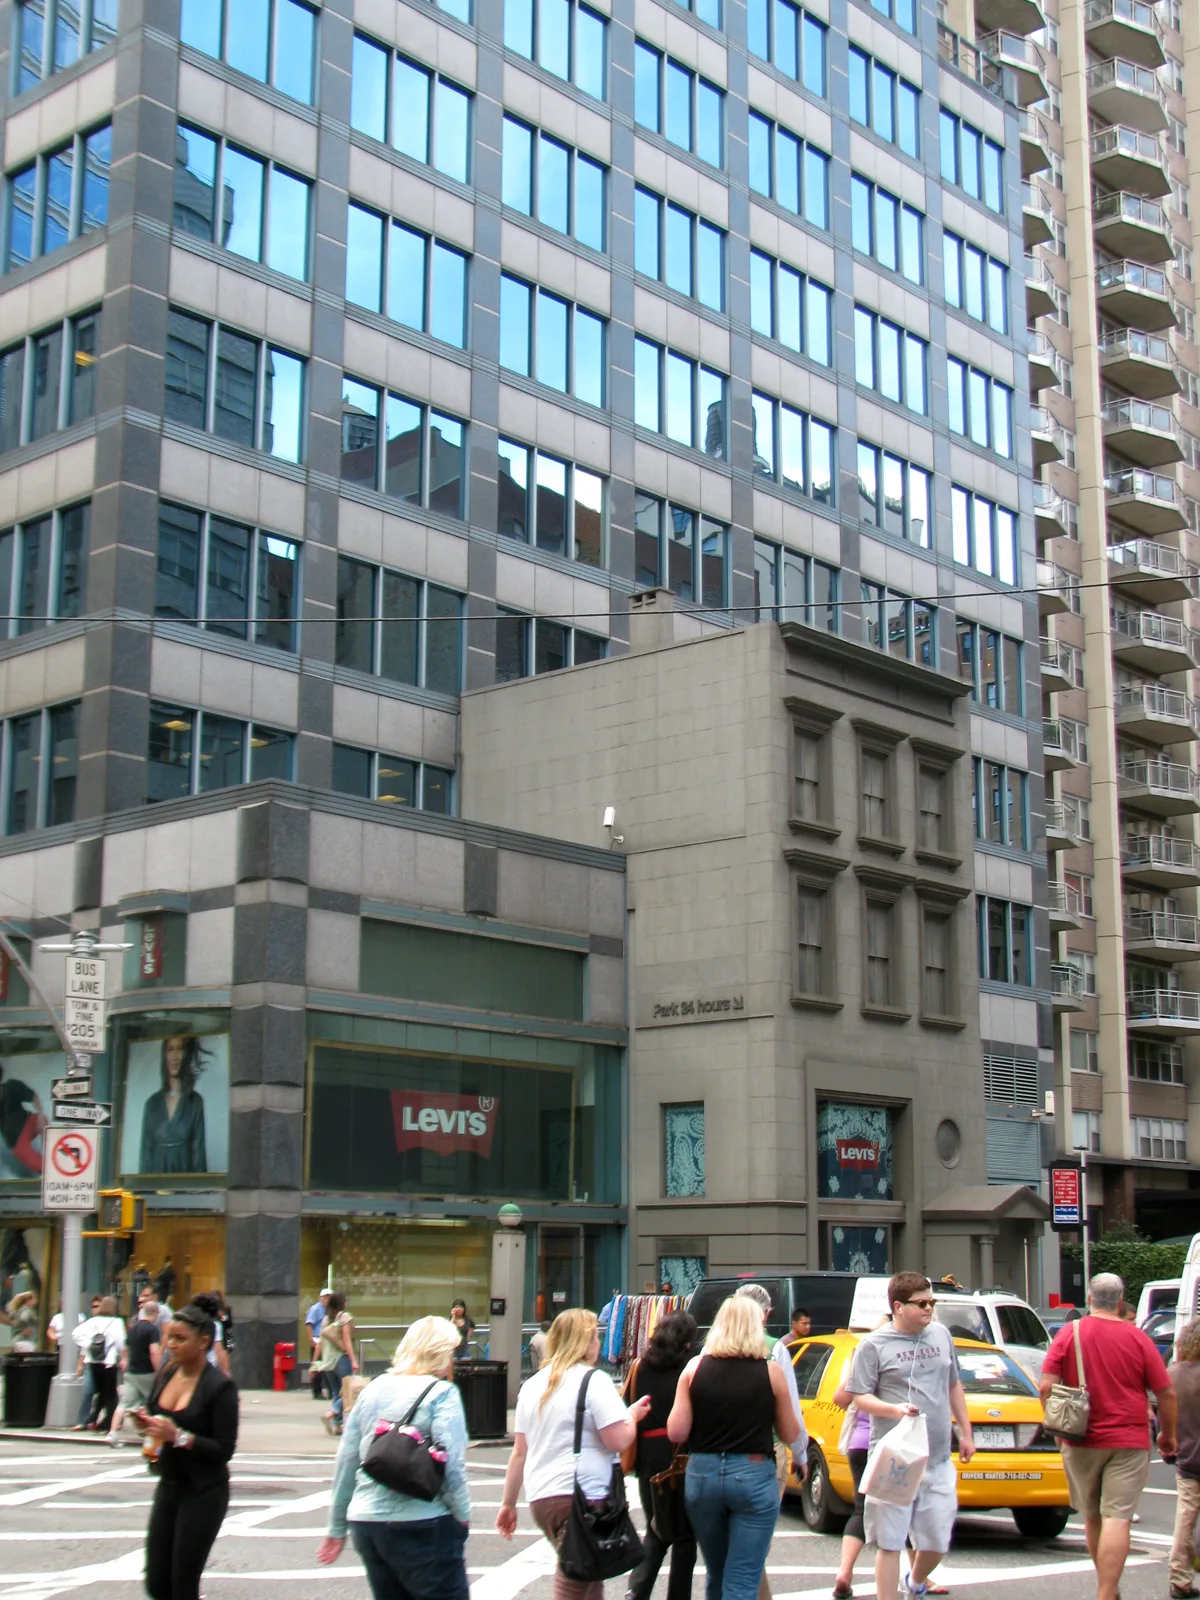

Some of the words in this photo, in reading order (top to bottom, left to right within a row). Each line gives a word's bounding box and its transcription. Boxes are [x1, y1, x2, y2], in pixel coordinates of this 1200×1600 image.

[75, 962, 96, 976] BUS
[71, 980, 99, 994] LANE
[72, 1000, 88, 1010] TOW
[92, 1002, 98, 1011] &
[652, 1002, 679, 1018] Park
[681, 1000, 695, 1015] 24
[697, 999, 730, 1014] hours
[75, 1012, 94, 1022] FINE
[60, 1107, 78, 1117] ONE
[86, 1109, 103, 1119] WAY
[46, 1182, 93, 1191] 10AM-6PM
[48, 1194, 90, 1204] MON-FRI
